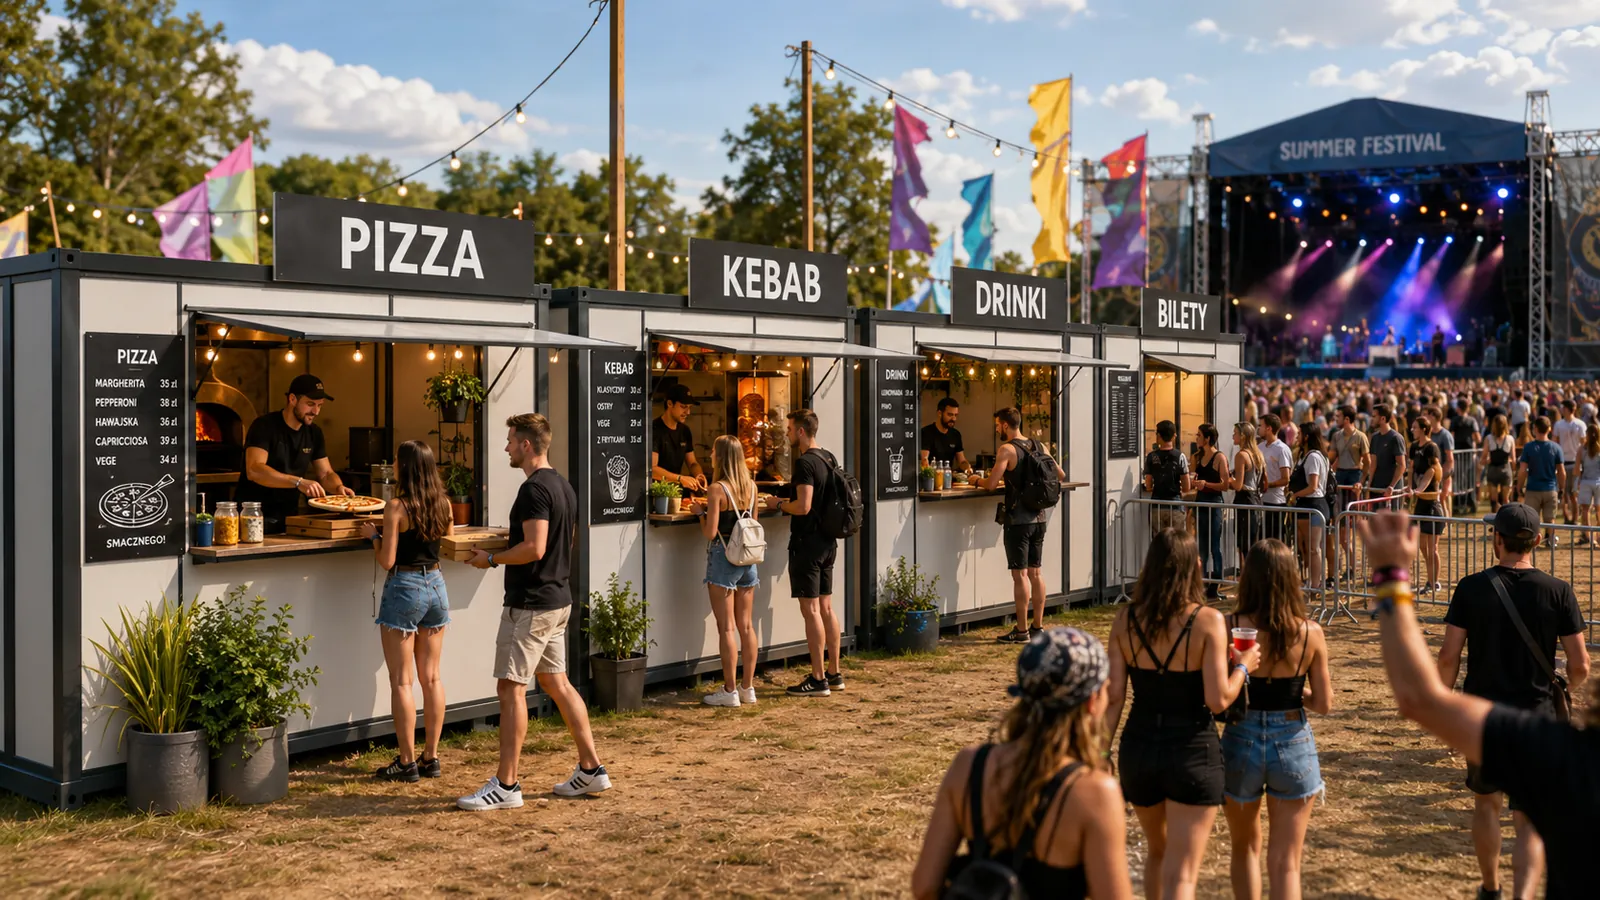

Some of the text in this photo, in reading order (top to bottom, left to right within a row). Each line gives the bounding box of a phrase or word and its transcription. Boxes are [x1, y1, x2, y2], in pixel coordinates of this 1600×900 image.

[1280, 132, 1446, 161] SUMMER FESTIVAL
[342, 217, 484, 279] PIZZA
[723, 255, 821, 303] KEBAB
[976, 280, 1046, 320] DRINKI
[1159, 299, 1207, 330] BILETY
[118, 349, 157, 364] PIZZA
[605, 362, 633, 374] KEBAB
[886, 369, 908, 380] DRINKI
[96, 379, 145, 387] MARGHERITA
[160, 379, 169, 388] 35
[96, 398, 136, 407] PEPPERONI
[160, 398, 169, 407] 38
[96, 418, 138, 426] HAWAJSKA
[160, 417, 169, 426] 36
[596, 420, 611, 428] VEGE
[96, 437, 148, 446] CAPRICCIOSA
[161, 436, 169, 445] 39
[96, 457, 116, 465] VEGE
[160, 455, 169, 463] 34
[107, 536, 165, 548] SMACZNEGO!
